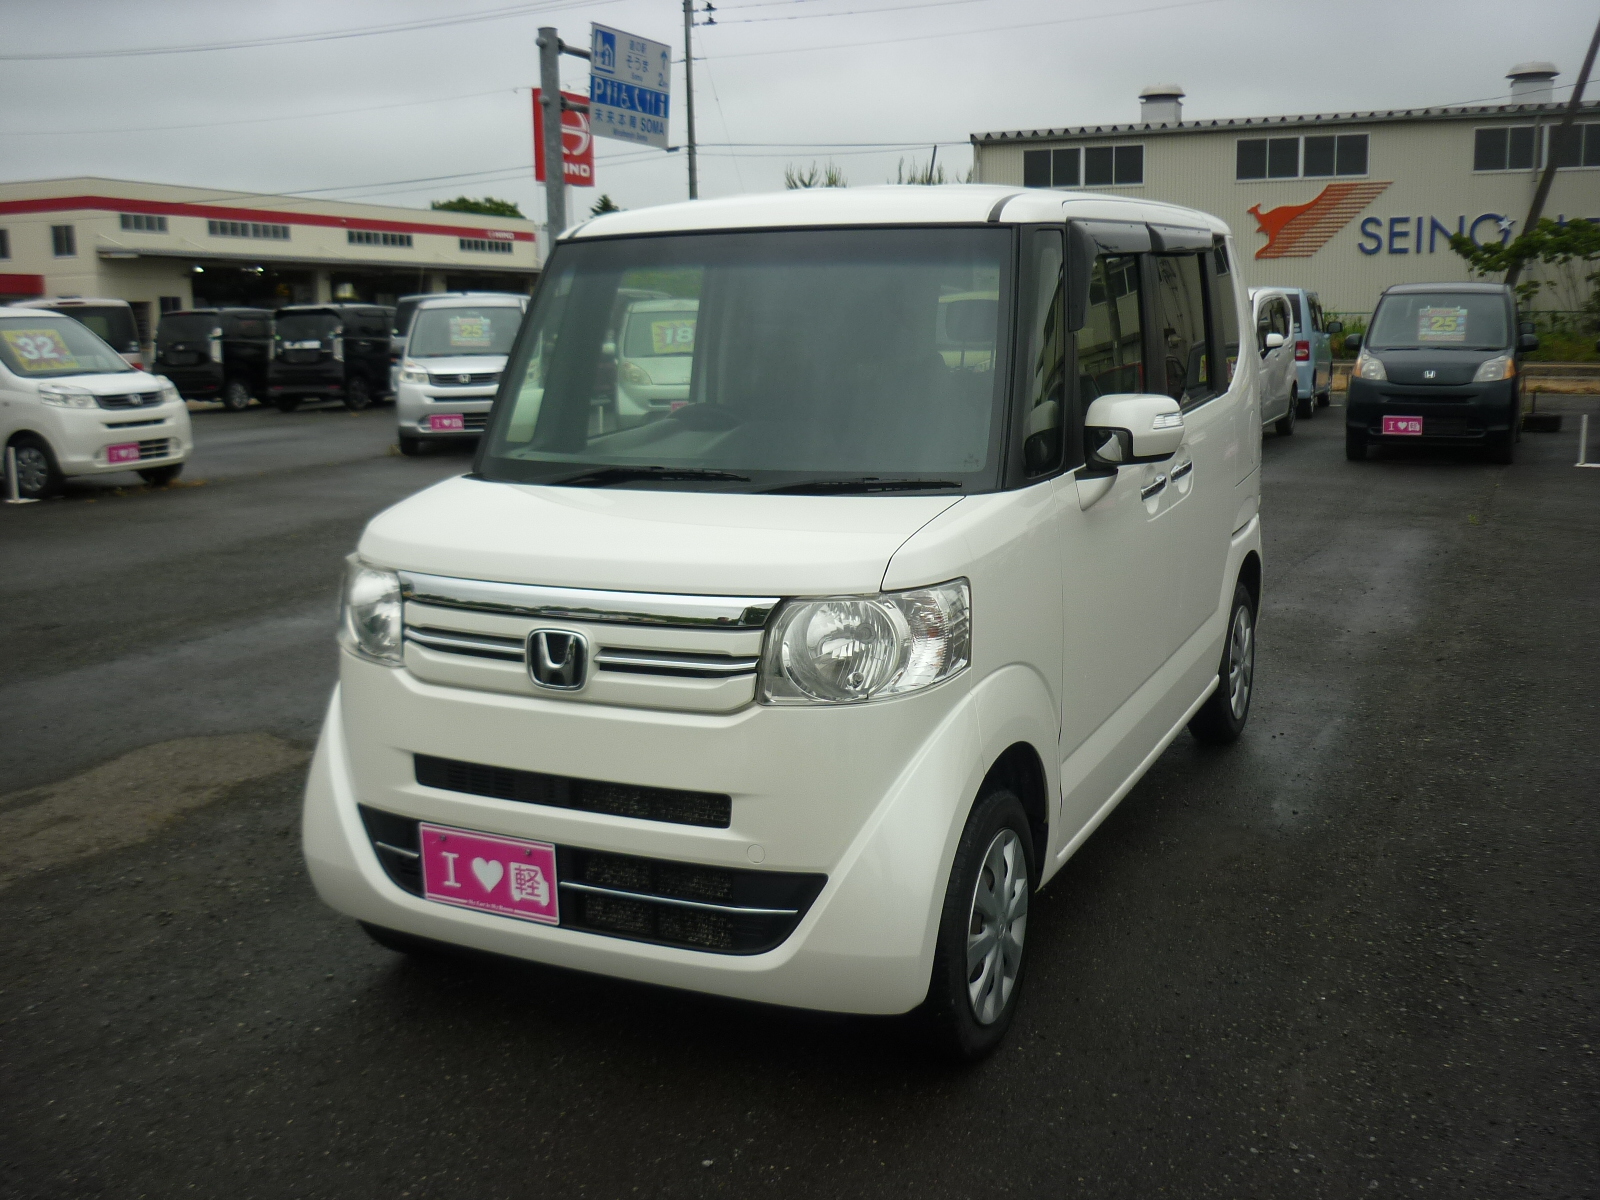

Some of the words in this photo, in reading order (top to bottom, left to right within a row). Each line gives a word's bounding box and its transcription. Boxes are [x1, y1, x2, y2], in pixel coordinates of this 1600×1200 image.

[640, 117, 665, 136] SOMA
[563, 162, 591, 178] INO
[460, 324, 483, 338] 25
[1430, 316, 1458, 331] 25
[665, 327, 694, 344] 18
[16, 335, 60, 360] 32
[441, 851, 462, 888] I
[510, 862, 546, 902] 軽
